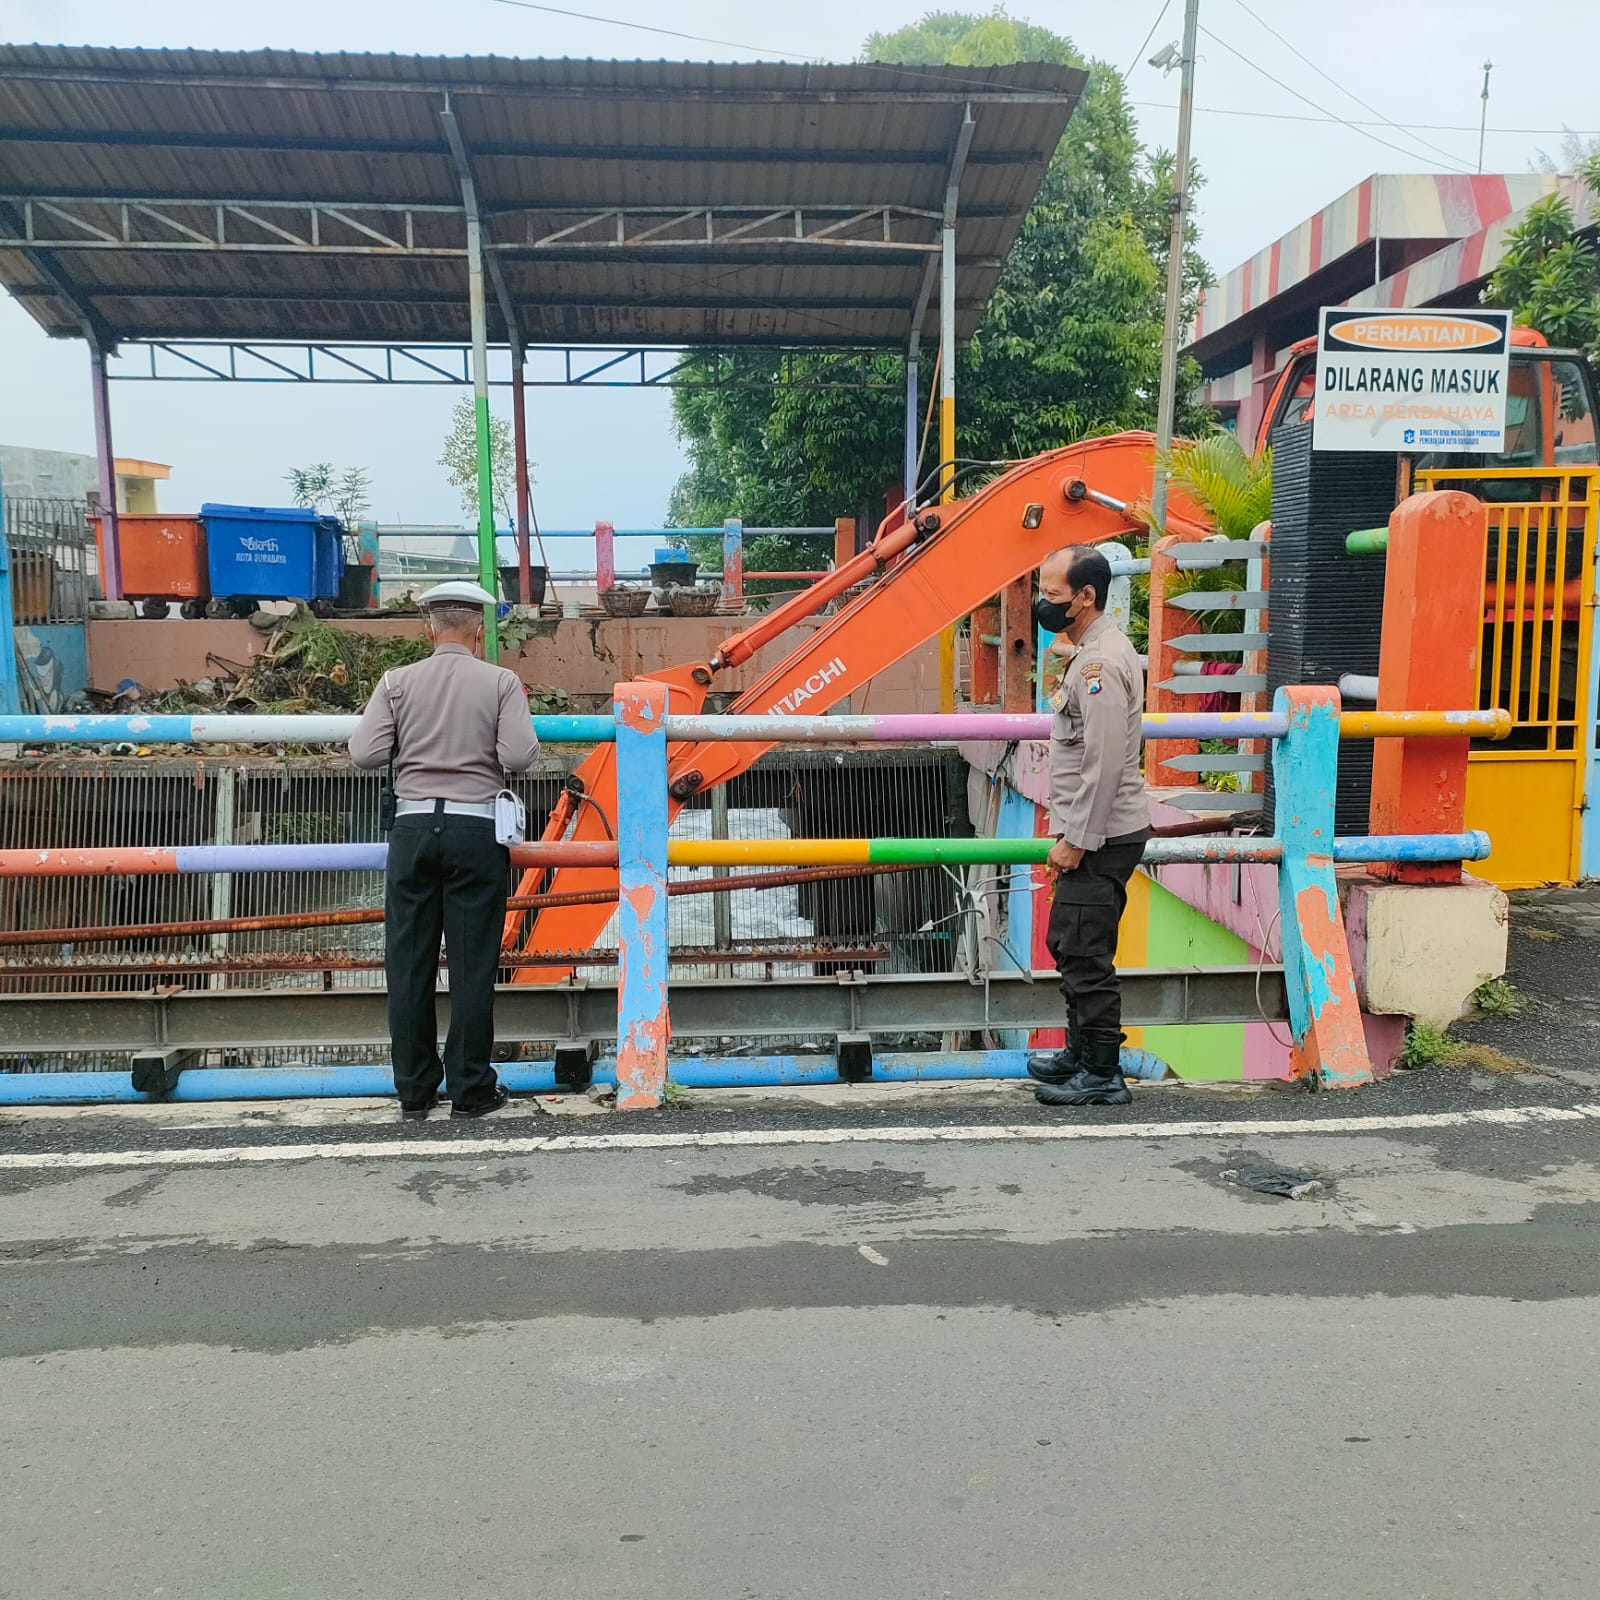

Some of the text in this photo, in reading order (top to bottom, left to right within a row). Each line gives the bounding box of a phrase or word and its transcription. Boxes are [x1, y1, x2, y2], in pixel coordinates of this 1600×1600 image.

[1353, 324, 1478, 343] PERHATIAN !
[1324, 366, 1500, 394] DILARANG MASUK
[1325, 403, 1495, 421] AREA BERBAHAYA
[235, 552, 253, 562] KOTA
